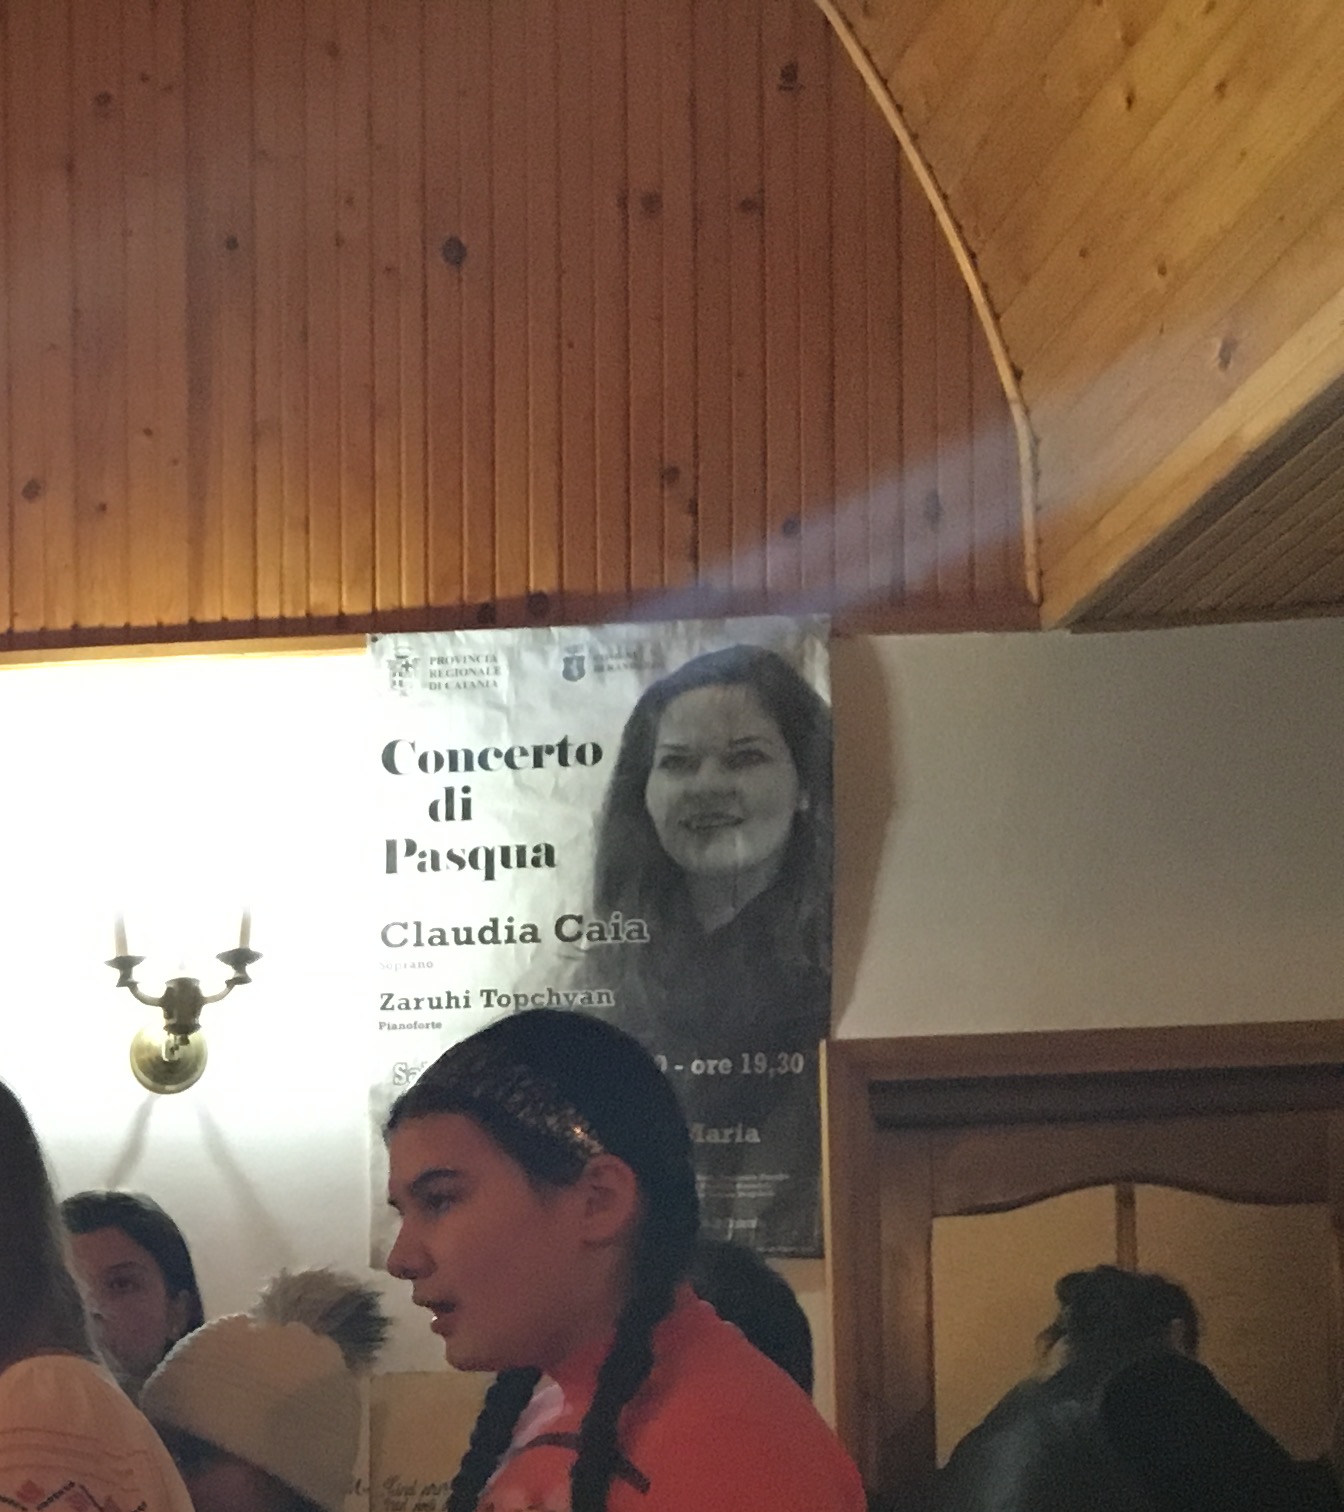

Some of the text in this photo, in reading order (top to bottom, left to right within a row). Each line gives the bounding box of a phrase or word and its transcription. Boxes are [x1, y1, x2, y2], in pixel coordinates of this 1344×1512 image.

[428, 665, 501, 679] REGIONALE
[429, 654, 498, 666] PROVINCIA
[428, 679, 499, 691] DI CATANIA
[381, 735, 604, 776] Concerto
[428, 786, 472, 822] di
[385, 838, 558, 881] Pasqua
[380, 910, 652, 948] Claudia Caia
[379, 989, 471, 1012] Zaruhi
[378, 1019, 443, 1032] Pianoforte
[690, 1057, 733, 1075] ore
[740, 1051, 805, 1078] 19,30
